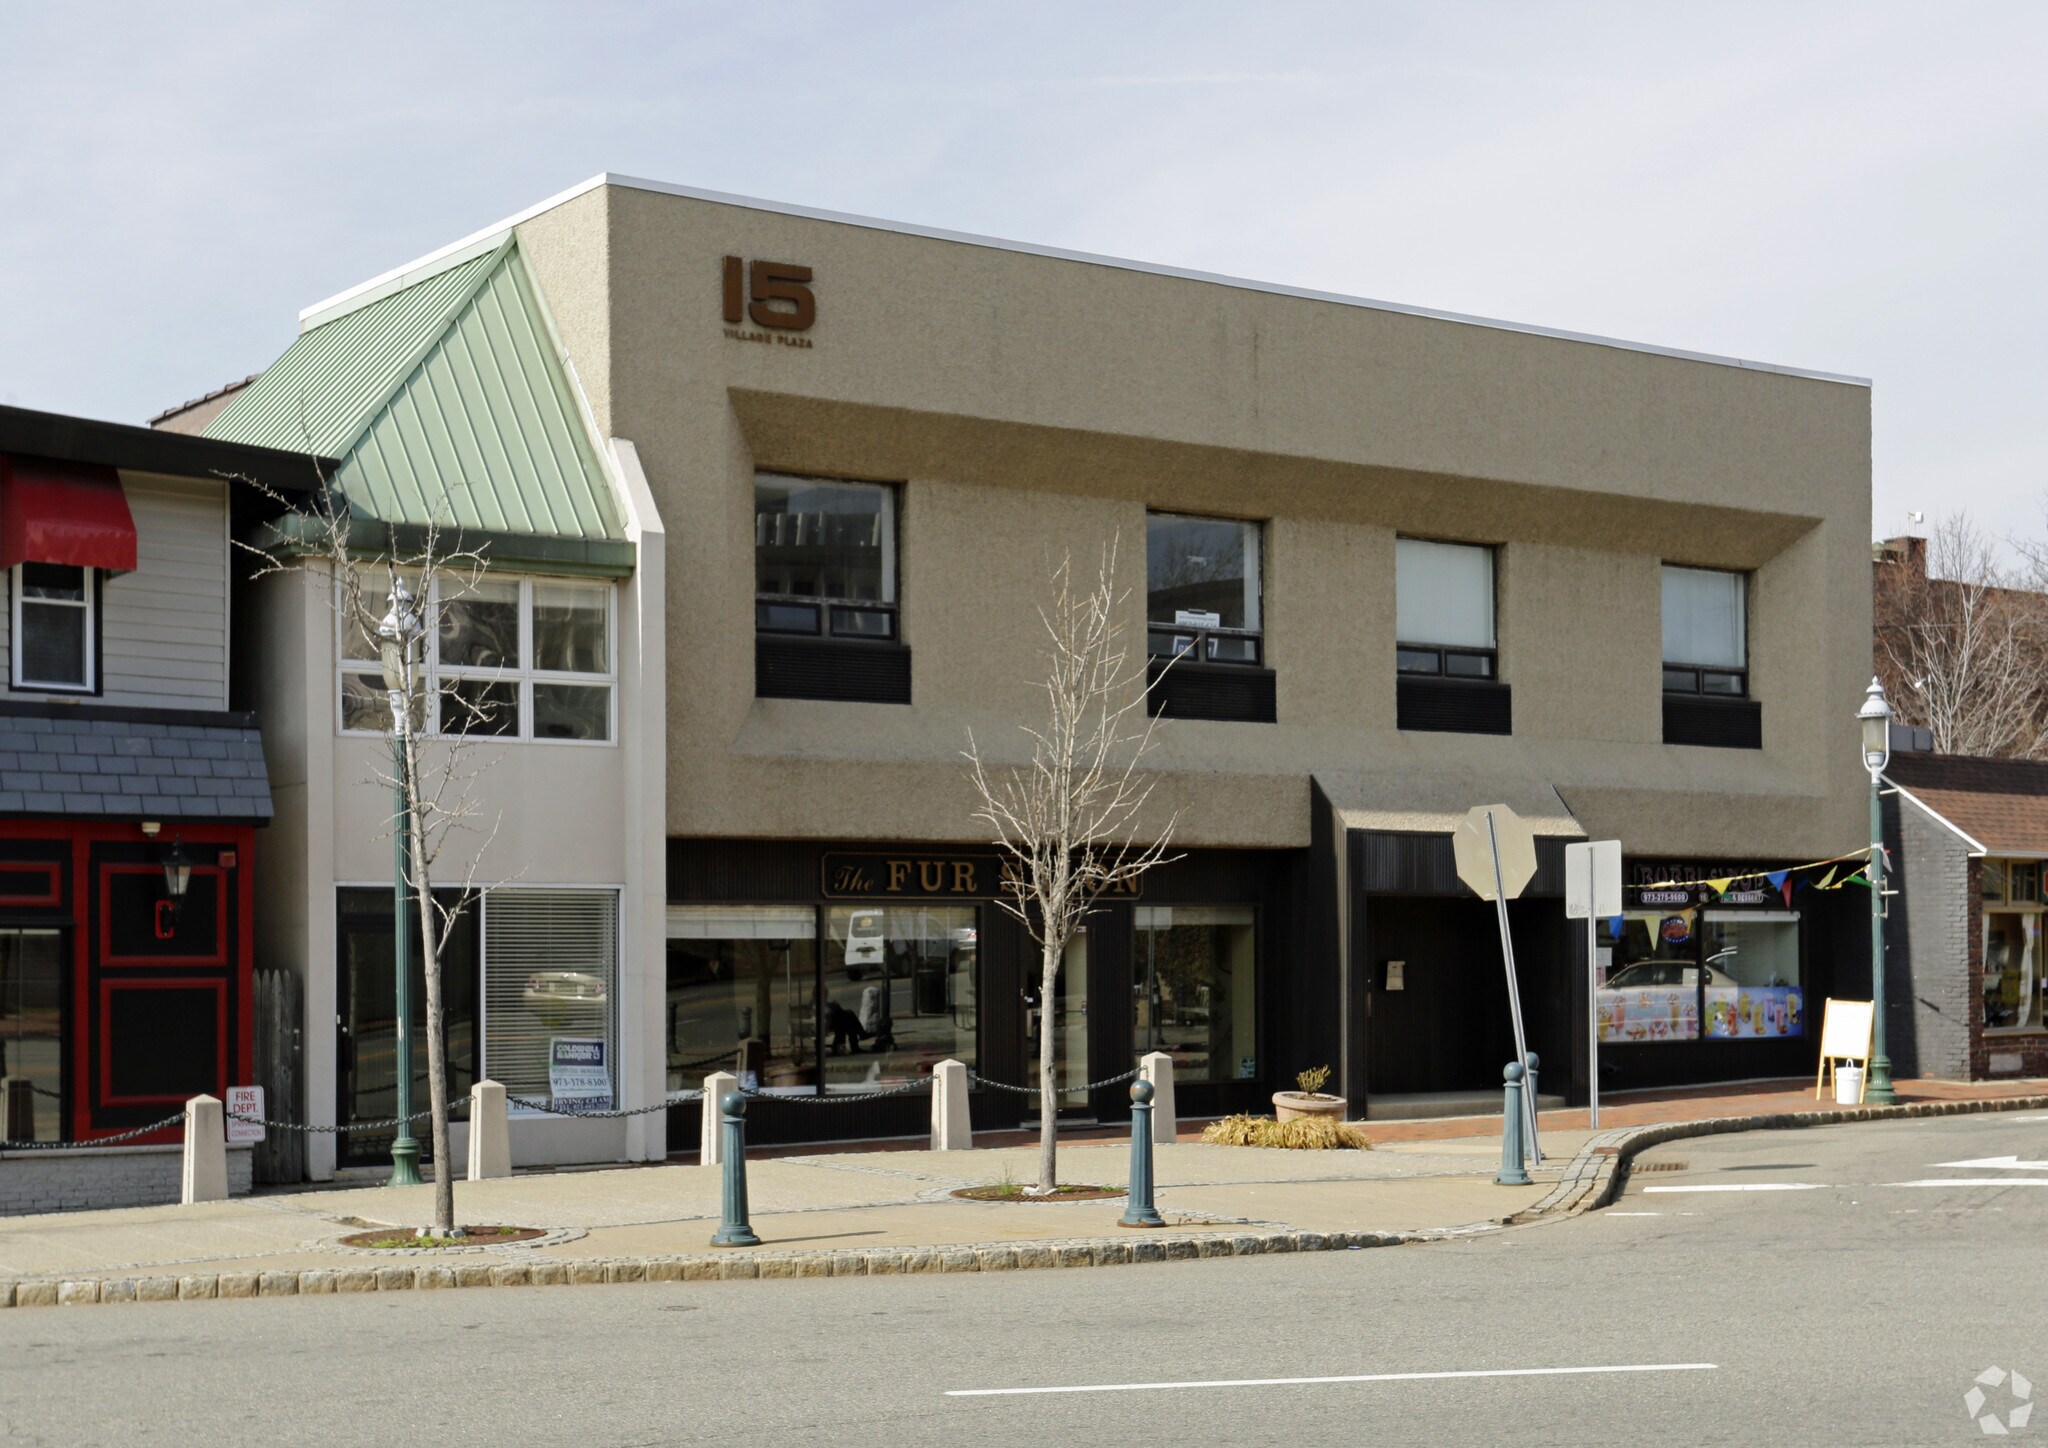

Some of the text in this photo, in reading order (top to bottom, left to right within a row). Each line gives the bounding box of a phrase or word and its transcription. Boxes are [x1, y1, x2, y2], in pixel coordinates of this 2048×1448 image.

[722, 255, 816, 331] 15
[723, 328, 813, 349] VILLAGE PLAZA
[833, 859, 1138, 894] The FUR SON
[556, 1044, 600, 1052] COLDWELL
[557, 1052, 592, 1060] BANKER
[235, 1091, 255, 1101] FIRE
[233, 1103, 259, 1113] DEPT.
